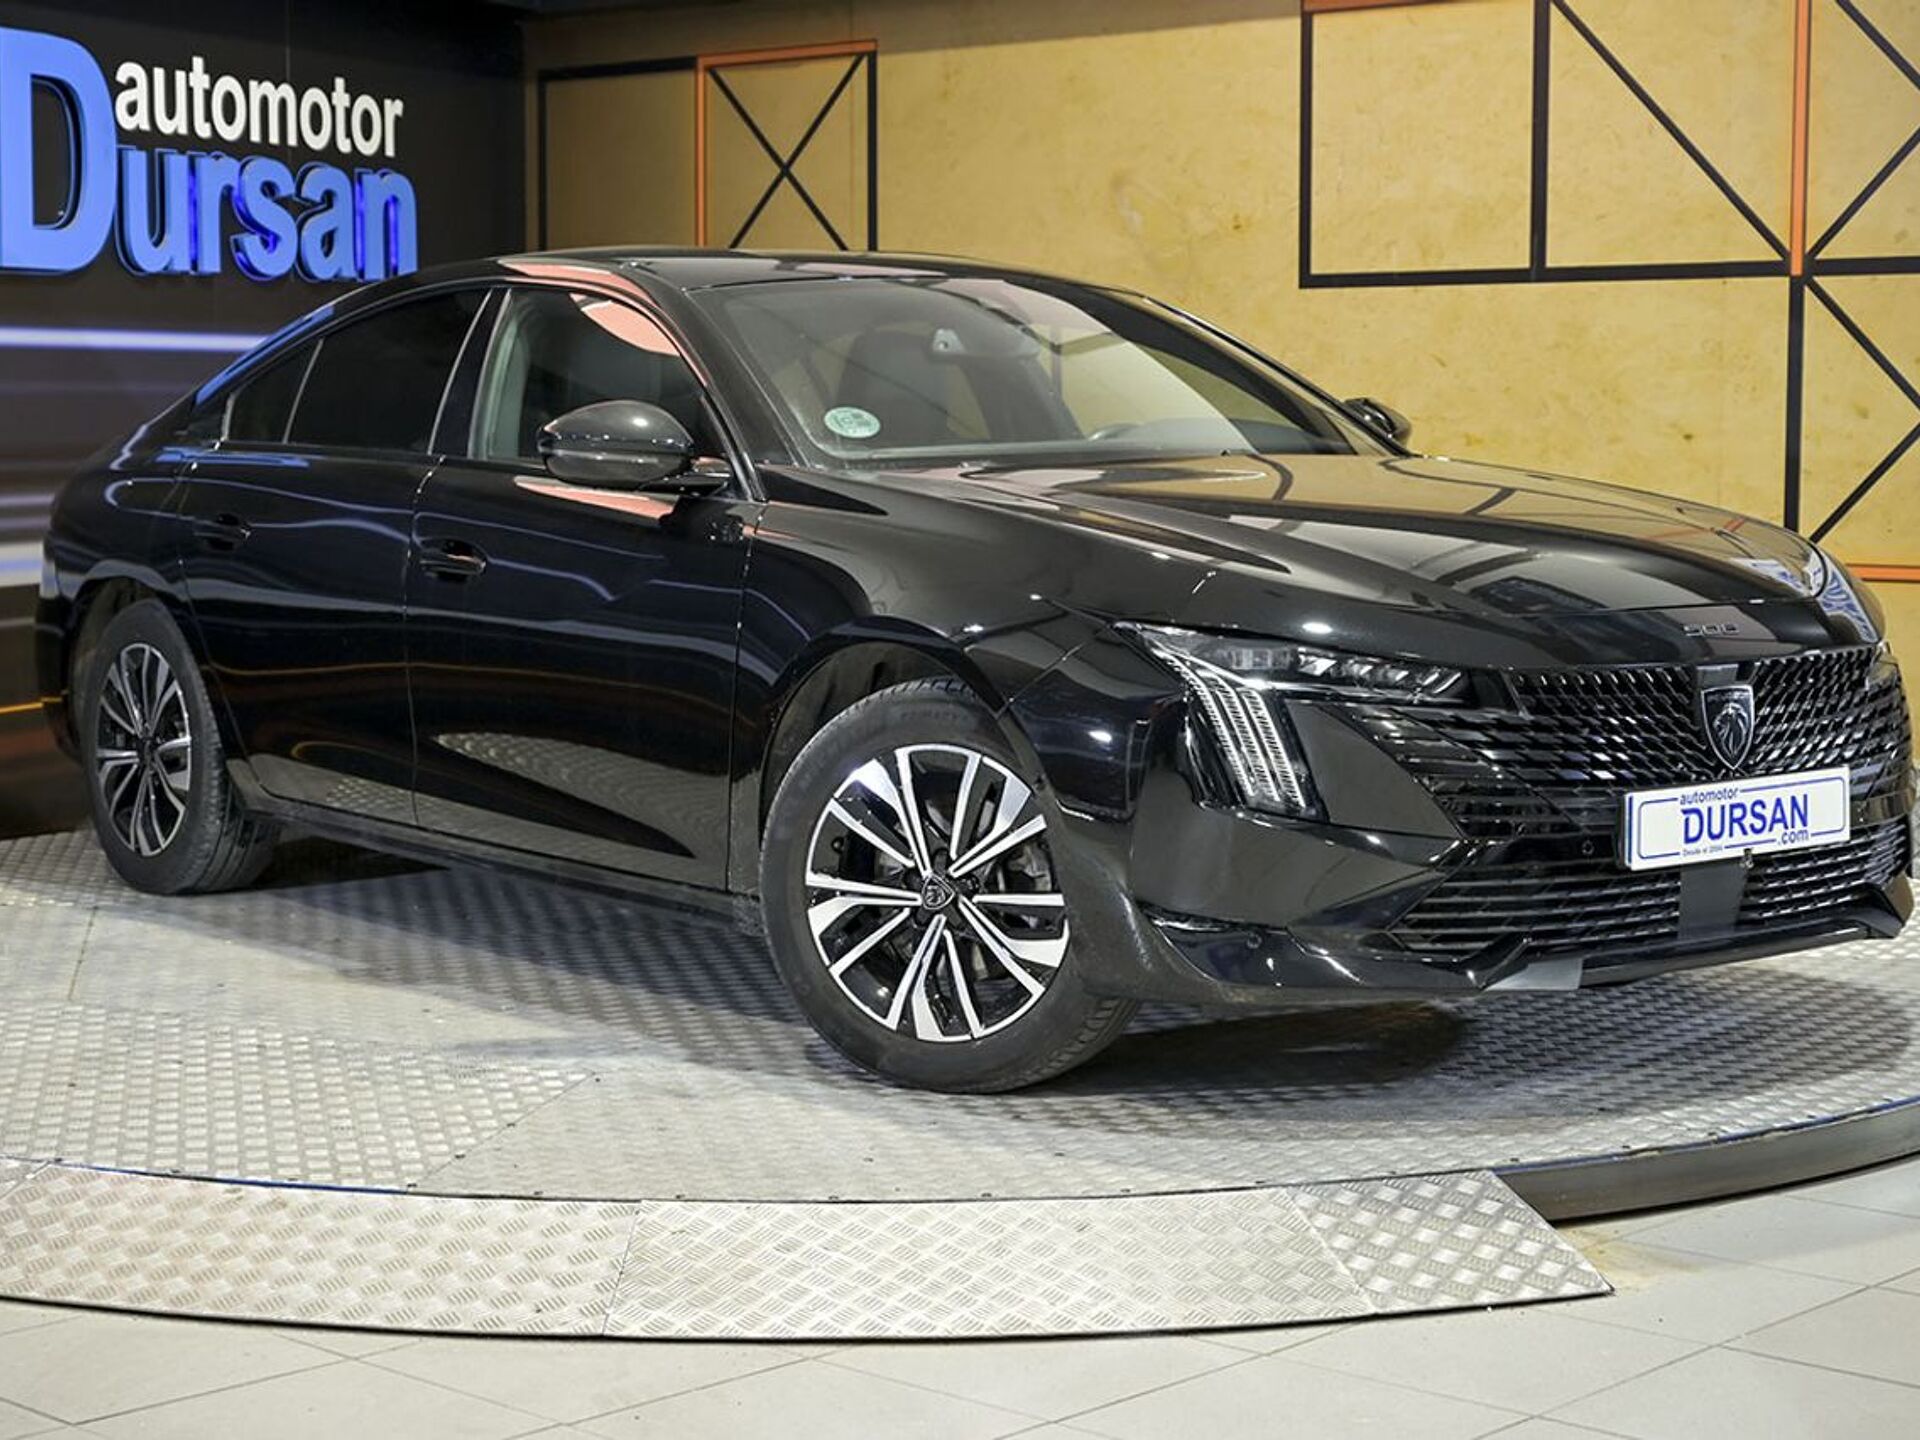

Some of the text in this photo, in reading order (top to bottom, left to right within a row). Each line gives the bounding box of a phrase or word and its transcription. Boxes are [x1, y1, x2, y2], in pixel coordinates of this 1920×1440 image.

[115, 56, 403, 157] automotor
[0, 26, 418, 282] Dursan
[1680, 787, 1739, 805] automotor
[1681, 793, 1809, 844] DURSAN
